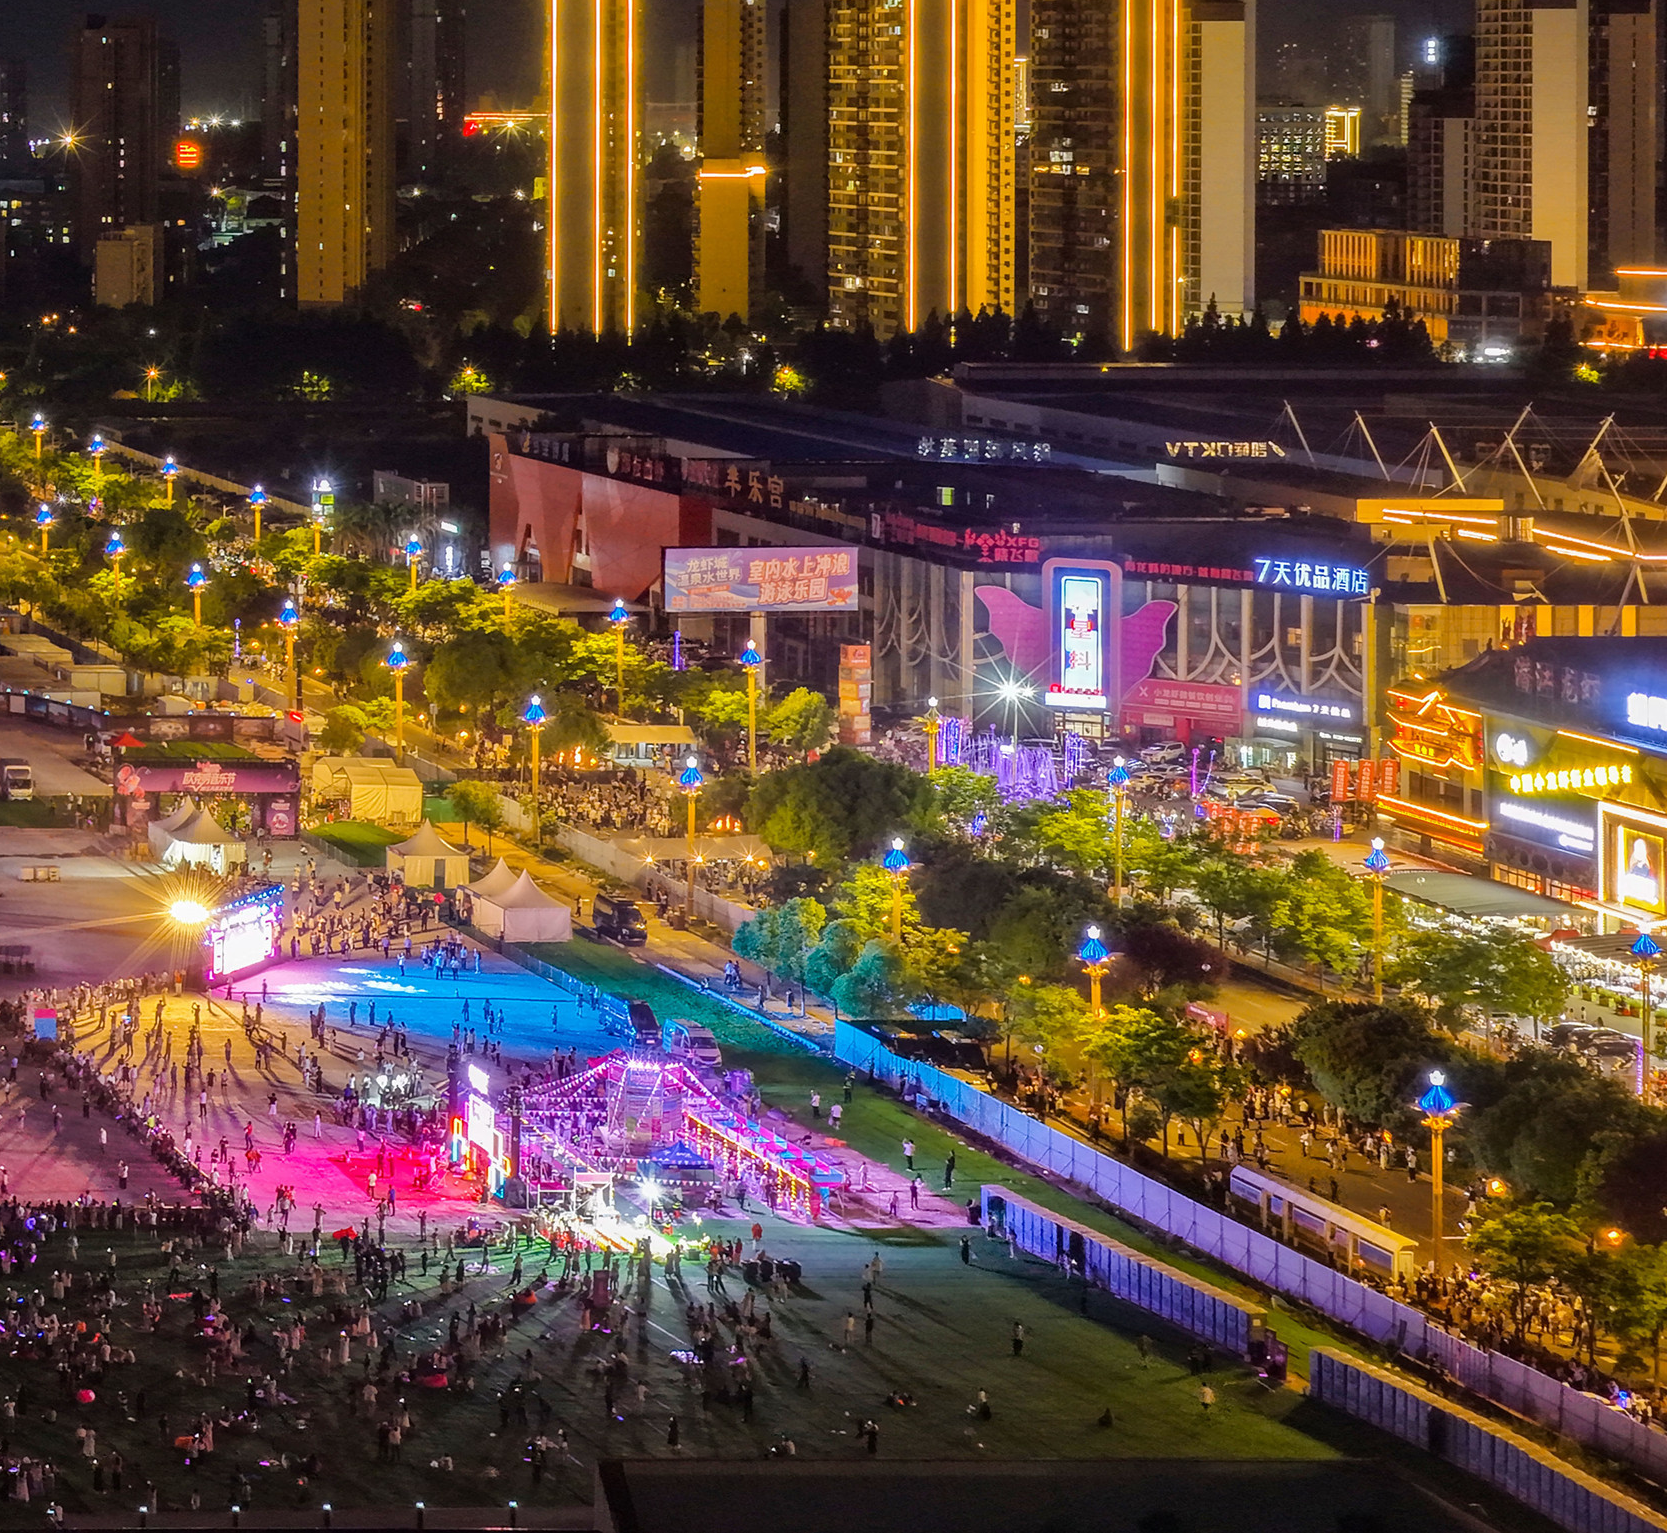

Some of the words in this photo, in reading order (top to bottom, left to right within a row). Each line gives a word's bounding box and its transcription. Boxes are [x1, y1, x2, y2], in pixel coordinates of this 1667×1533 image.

[1006, 536, 1040, 548] XFG
[686, 556, 729, 573] 龙虾城
[749, 553, 850, 582] 室内水上冲浪
[1254, 558, 1369, 593] 7天优品酒店
[677, 567, 742, 588] 温泉水世界
[758, 578, 827, 605] 游泳乐园
